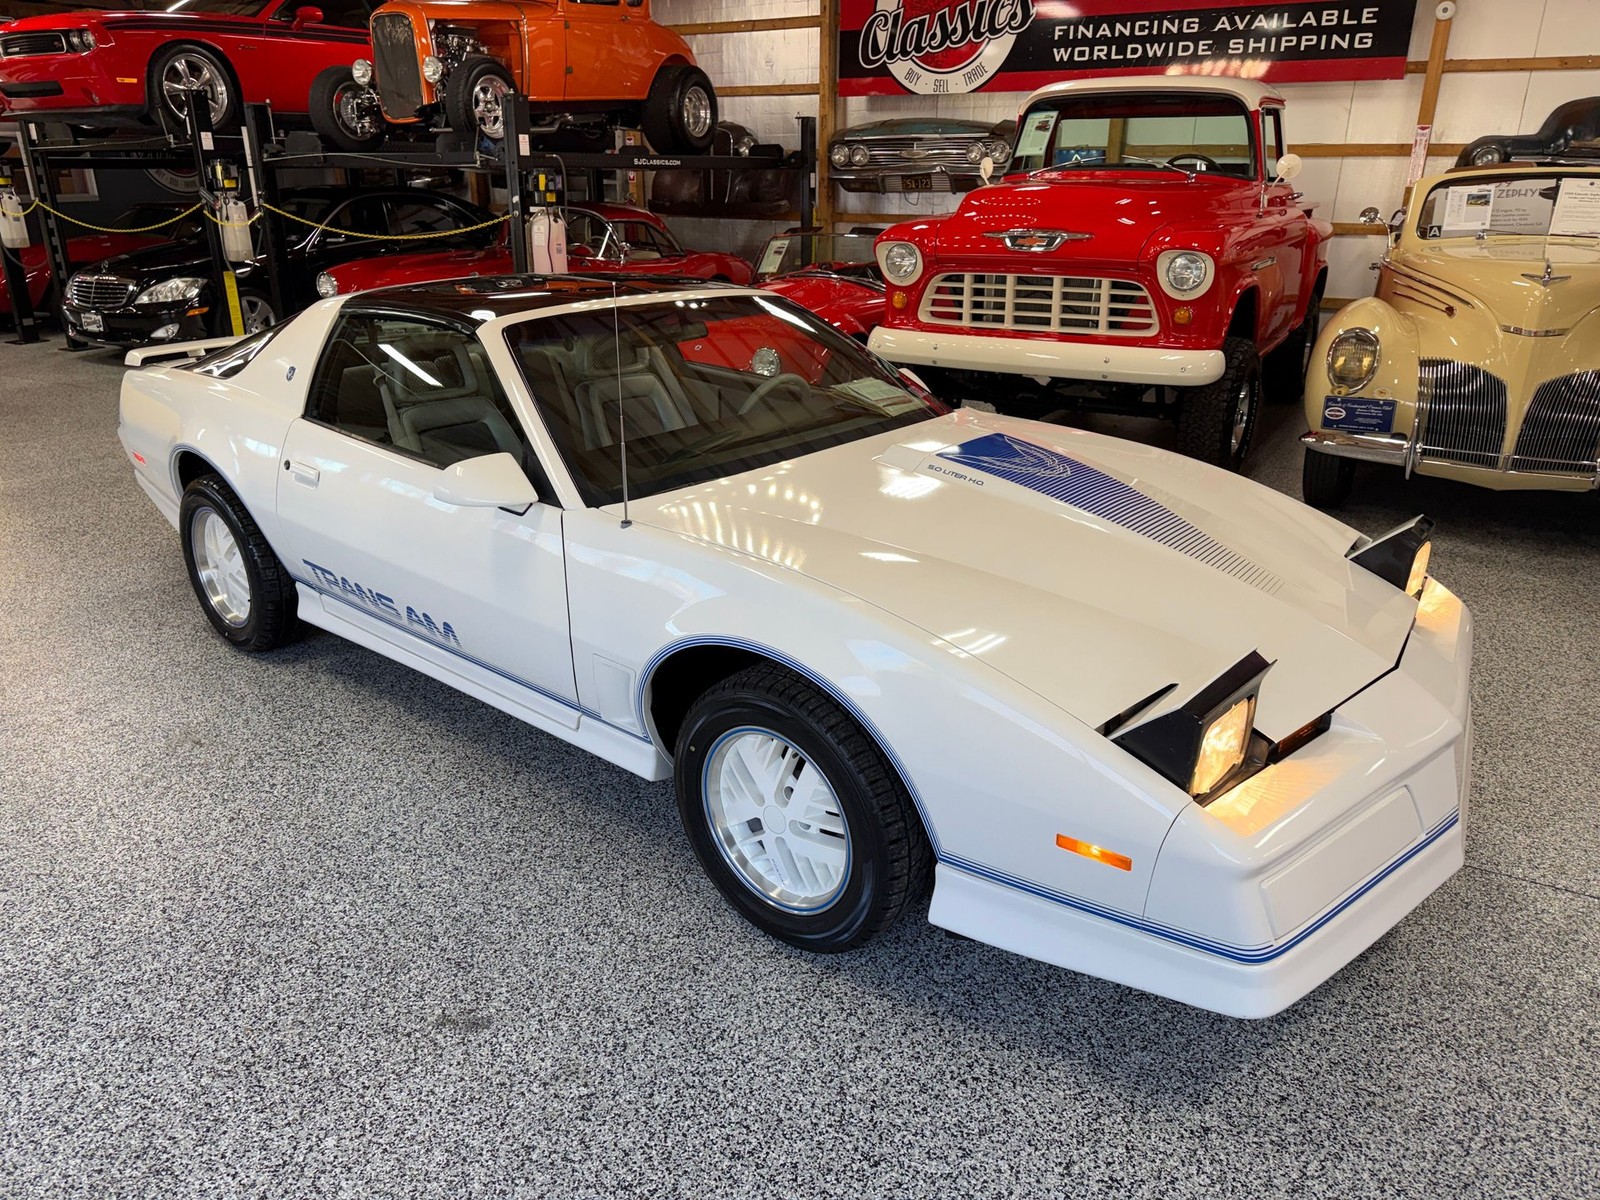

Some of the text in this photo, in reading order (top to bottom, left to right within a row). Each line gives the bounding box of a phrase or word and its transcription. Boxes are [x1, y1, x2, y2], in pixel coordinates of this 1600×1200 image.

[859, 0, 1036, 68] Classics
[1053, 7, 1379, 40] FINANCING AVAILABLE
[1053, 32, 1373, 62] WORLDWIDE SHIPPING
[903, 62, 988, 93] BUY SELL TRADE
[943, 469, 968, 480] LITER
[302, 559, 463, 649] TRANS AM
